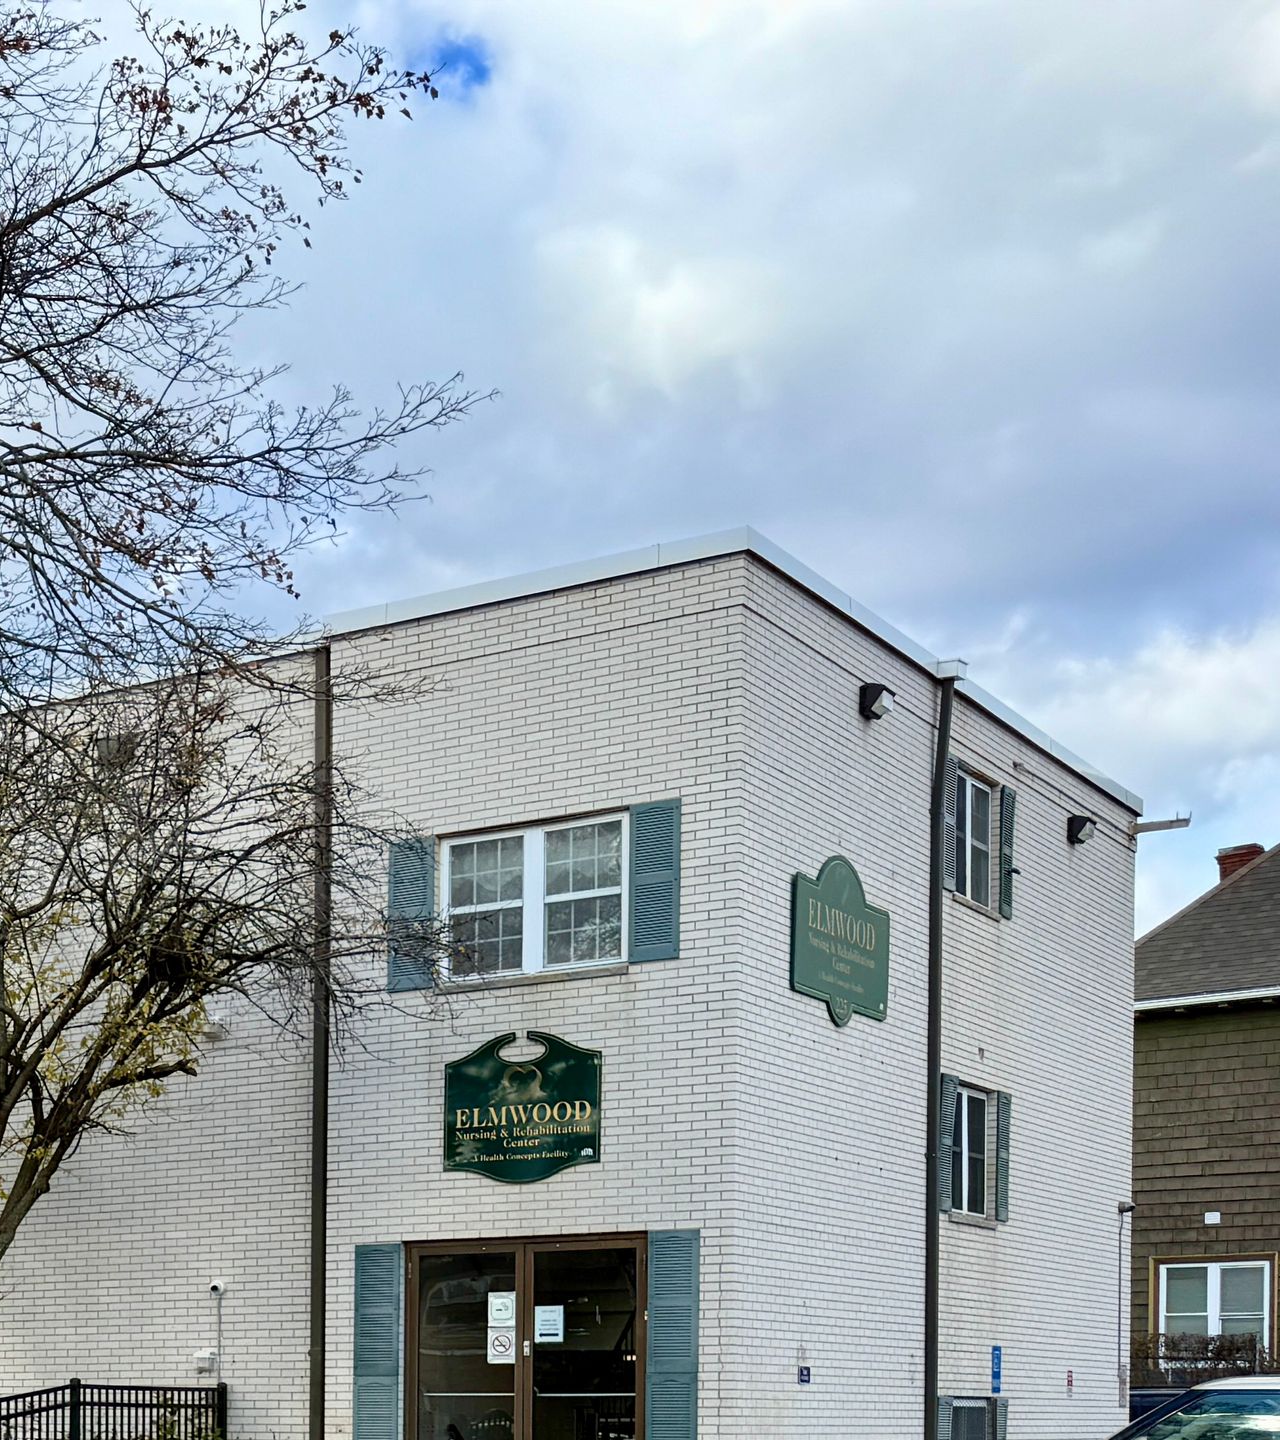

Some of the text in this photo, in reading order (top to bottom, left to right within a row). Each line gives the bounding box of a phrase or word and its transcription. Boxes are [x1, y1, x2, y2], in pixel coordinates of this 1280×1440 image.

[808, 898, 876, 951] ELMWOOD
[455, 1099, 592, 1129] ELMWOOD
[455, 1123, 590, 1141] Nursing & Rehabilitation
[503, 1138, 540, 1148] Center
[480, 1154, 505, 1162] Health
[506, 1152, 540, 1162] Concepts
[542, 1150, 569, 1159] Facility
